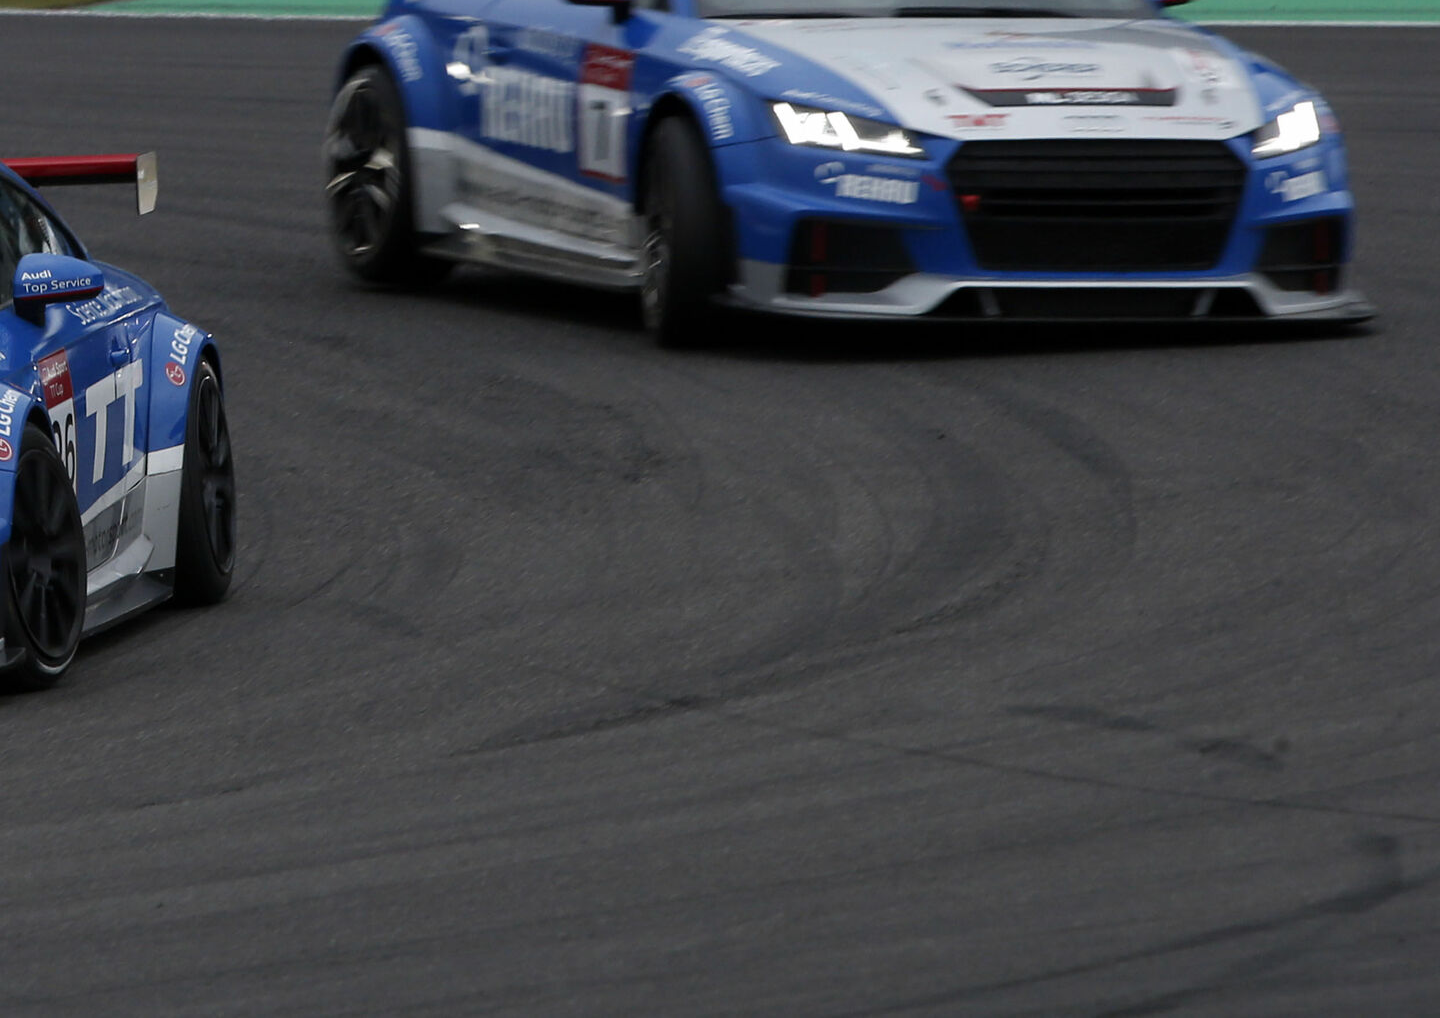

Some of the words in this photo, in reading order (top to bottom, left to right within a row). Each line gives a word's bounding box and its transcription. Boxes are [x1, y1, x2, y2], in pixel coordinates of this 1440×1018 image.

[21, 269, 52, 281] Audi
[23, 282, 48, 294] Top
[50, 277, 91, 290] Service
[170, 340, 188, 365] LG
[85, 358, 143, 484] TT
